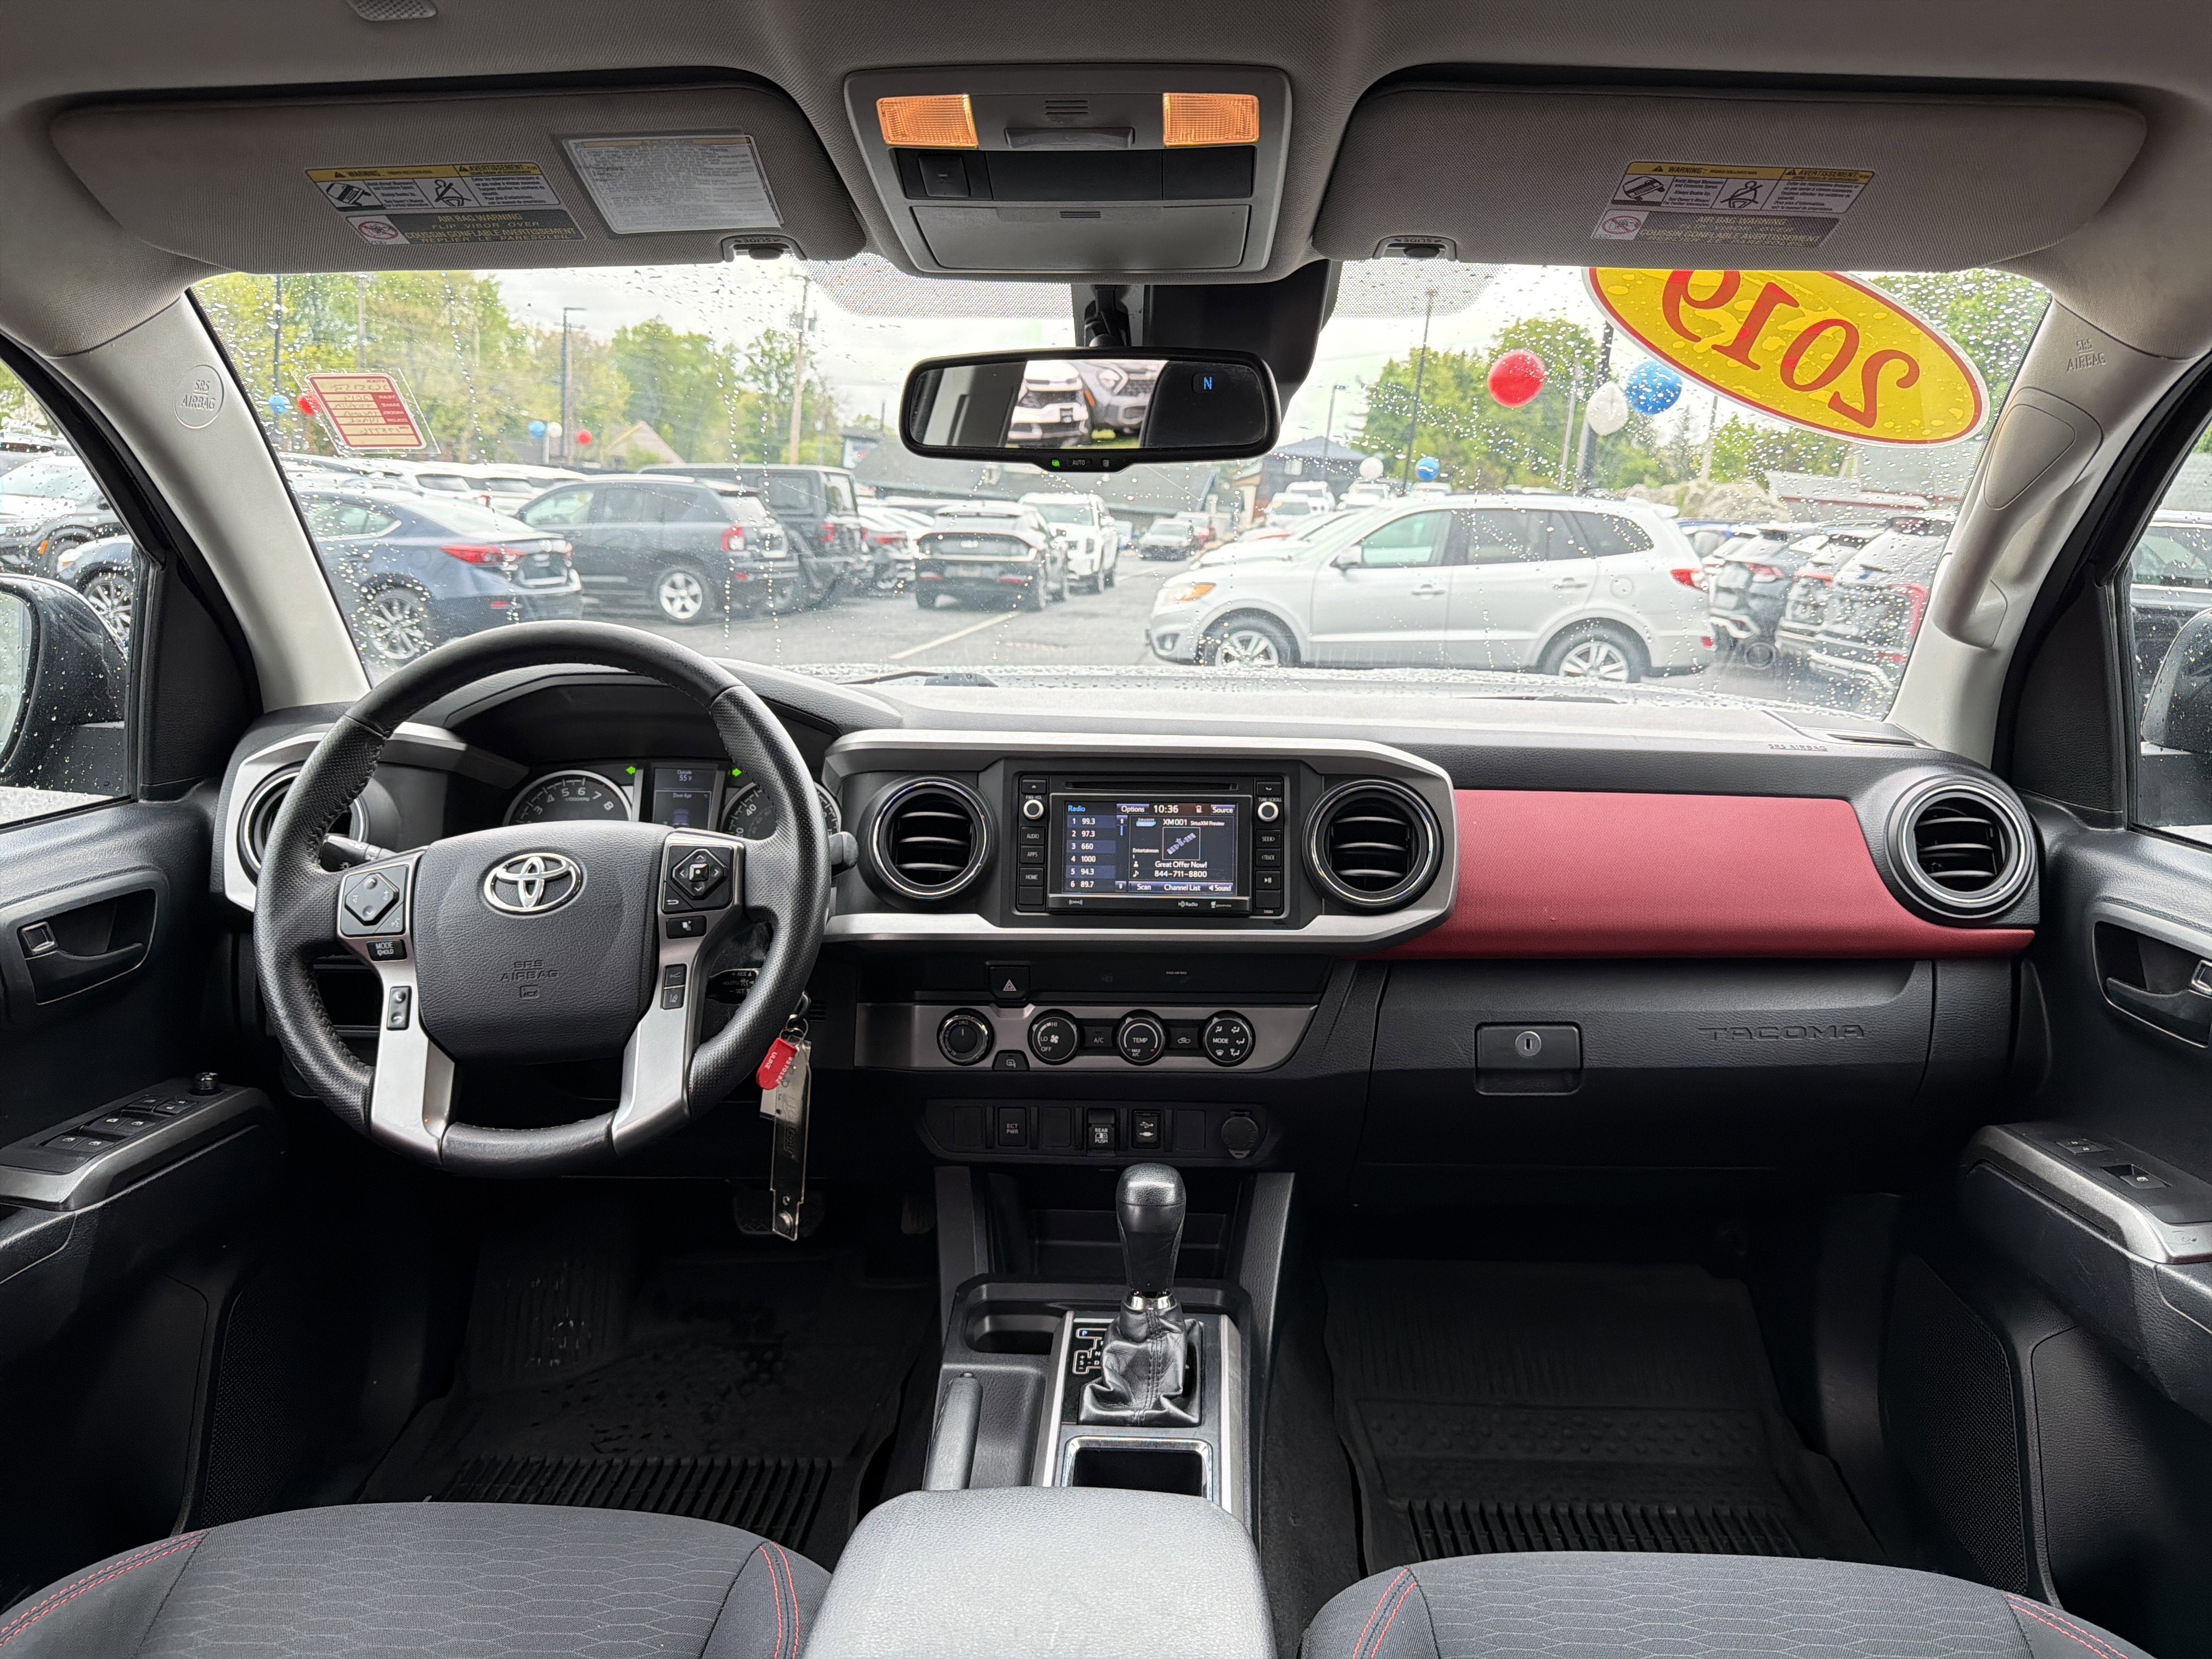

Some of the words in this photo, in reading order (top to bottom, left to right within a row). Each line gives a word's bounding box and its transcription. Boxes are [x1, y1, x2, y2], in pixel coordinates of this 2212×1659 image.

[502, 228, 575, 236] AVERTISSEMENT
[2076, 338, 2092, 352] SRS
[2066, 352, 2106, 373] AIRBAG
[194, 379, 210, 392] SRS
[1204, 376, 1212, 390] N
[180, 394, 216, 410] AIRBAG
[561, 788, 569, 796] 5
[592, 791, 602, 799] 7
[547, 794, 555, 803] 4
[533, 805, 543, 815] 3
[603, 801, 614, 810] 8
[746, 804, 757, 816] 40
[1154, 805, 1178, 813] 10:36
[514, 960, 544, 968] SRS
[500, 970, 558, 981] AIRBAG
[1698, 1024, 1865, 1041] TACOMA
